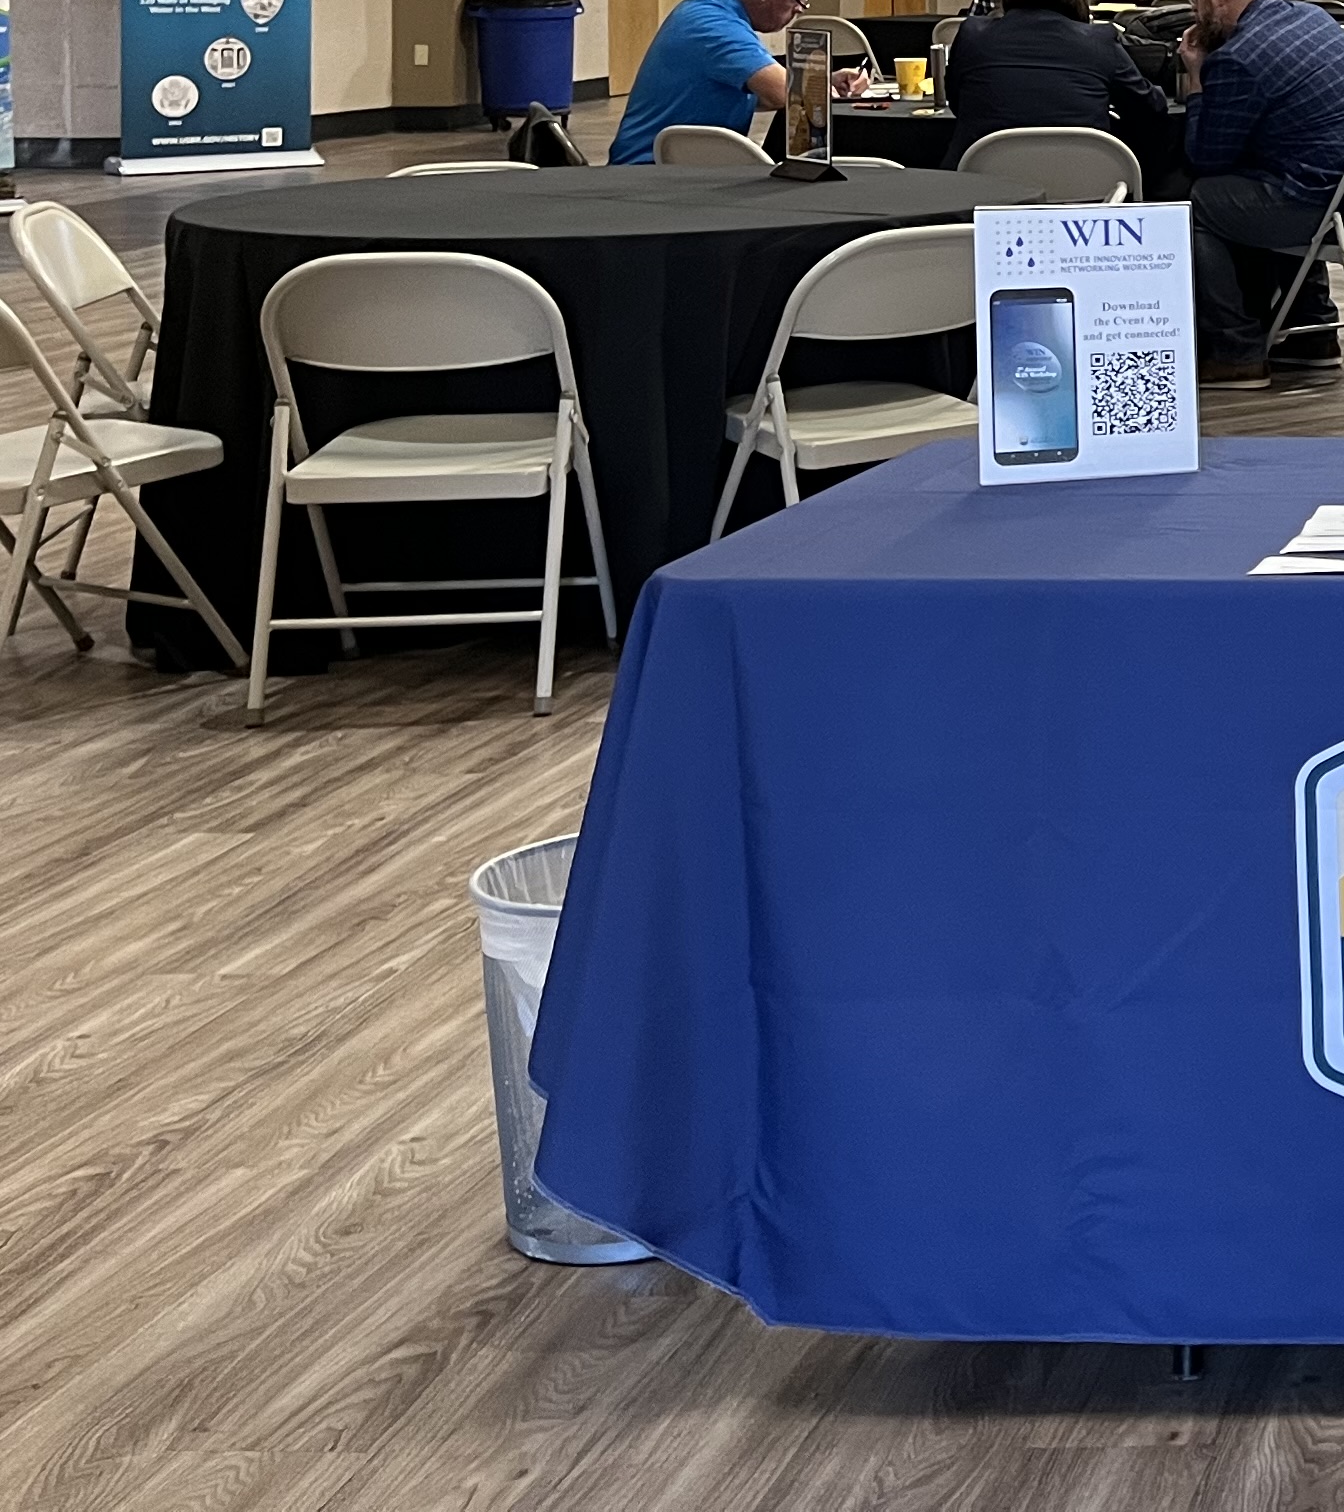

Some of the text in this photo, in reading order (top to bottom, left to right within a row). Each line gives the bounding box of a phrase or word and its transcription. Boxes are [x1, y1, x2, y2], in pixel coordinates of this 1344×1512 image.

[1060, 217, 1146, 248] WIN
[1060, 252, 1176, 265] WATER INNOVATIONS AND
[1060, 262, 1173, 274] NETWORKING WORKSHOP
[1102, 300, 1161, 312] Download
[1094, 317, 1110, 326] the
[1147, 315, 1170, 326] App
[1083, 327, 1181, 342] and get connected!
